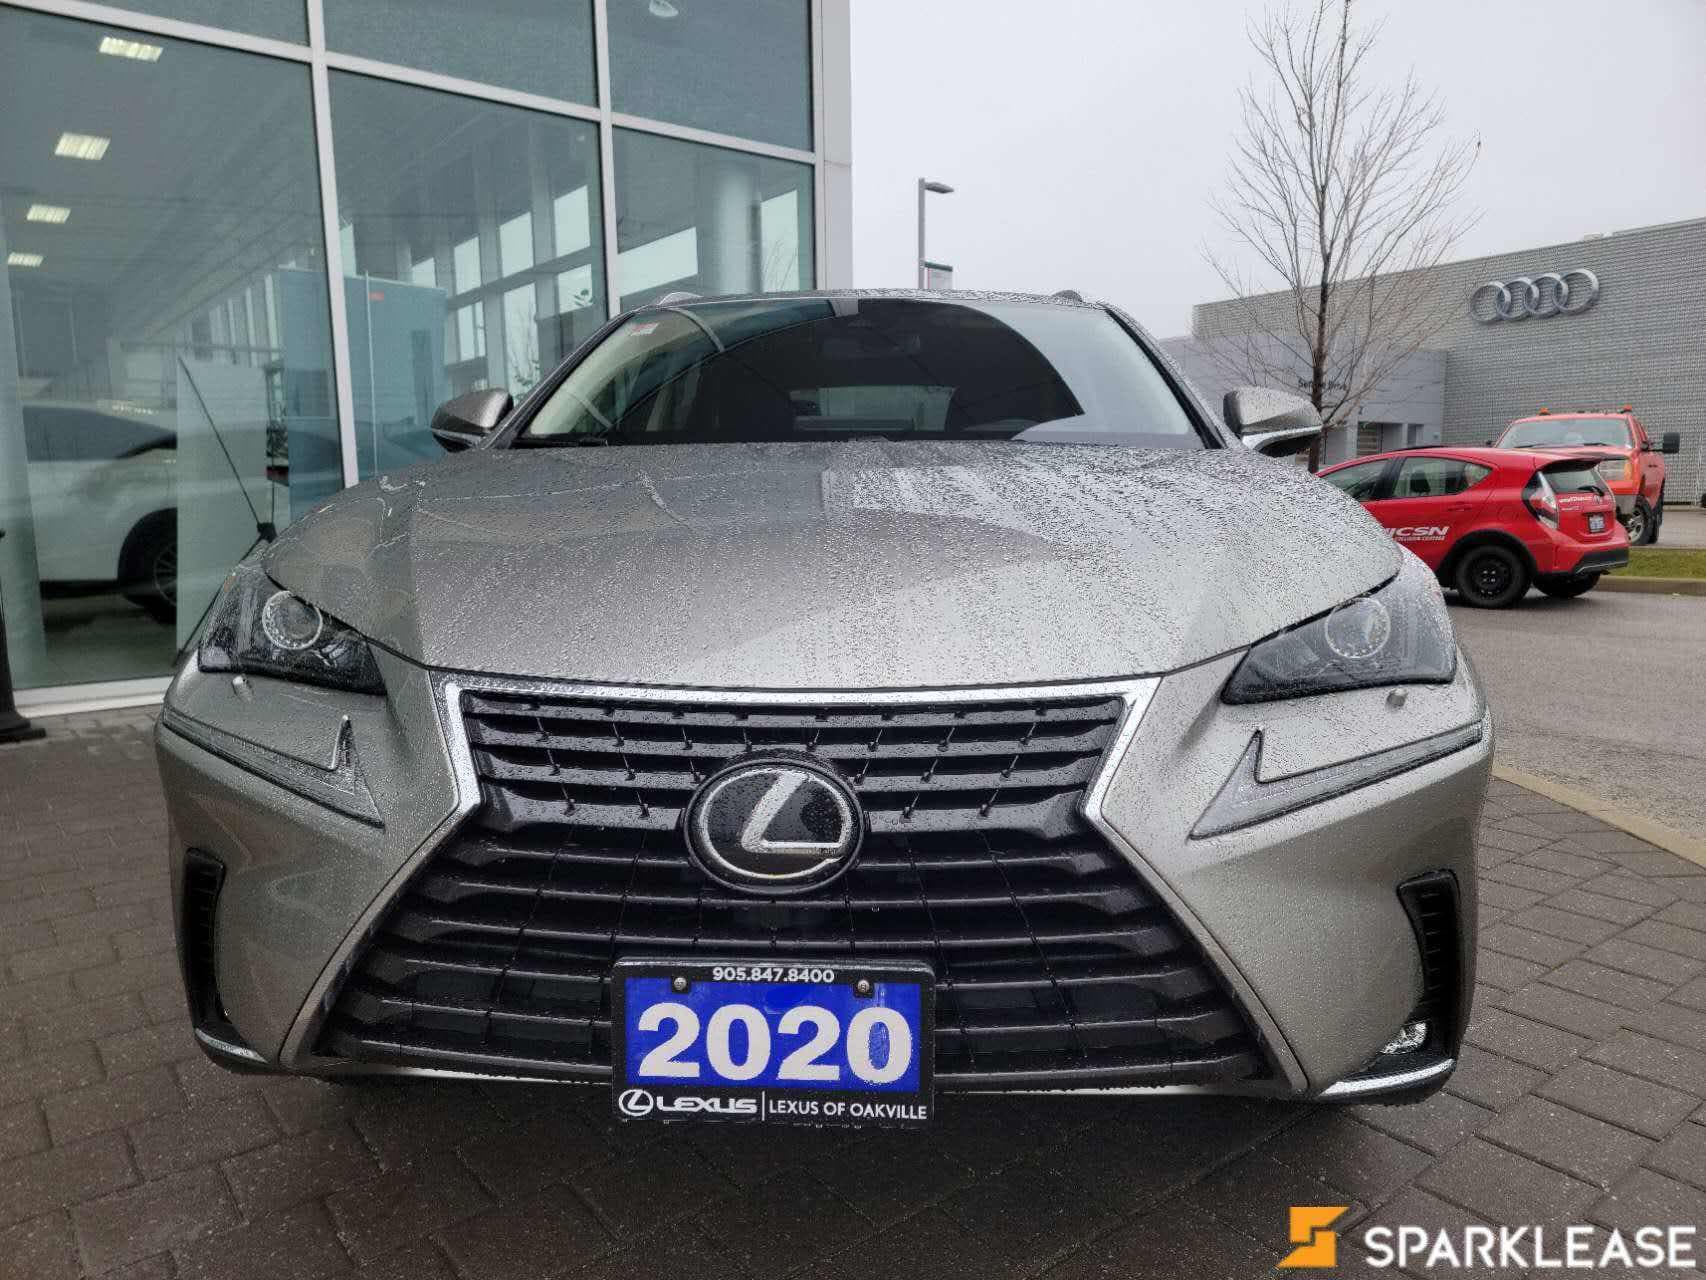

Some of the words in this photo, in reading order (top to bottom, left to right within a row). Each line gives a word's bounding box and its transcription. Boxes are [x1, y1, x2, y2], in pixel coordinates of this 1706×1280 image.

[712, 967, 835, 983] 905.847.8400
[637, 1002, 912, 1082] 2020
[656, 1096, 757, 1114] LEXUS
[769, 1099, 819, 1115] LEXUS
[823, 1102, 846, 1116] OF
[849, 1103, 928, 1120] OAKVILLE
